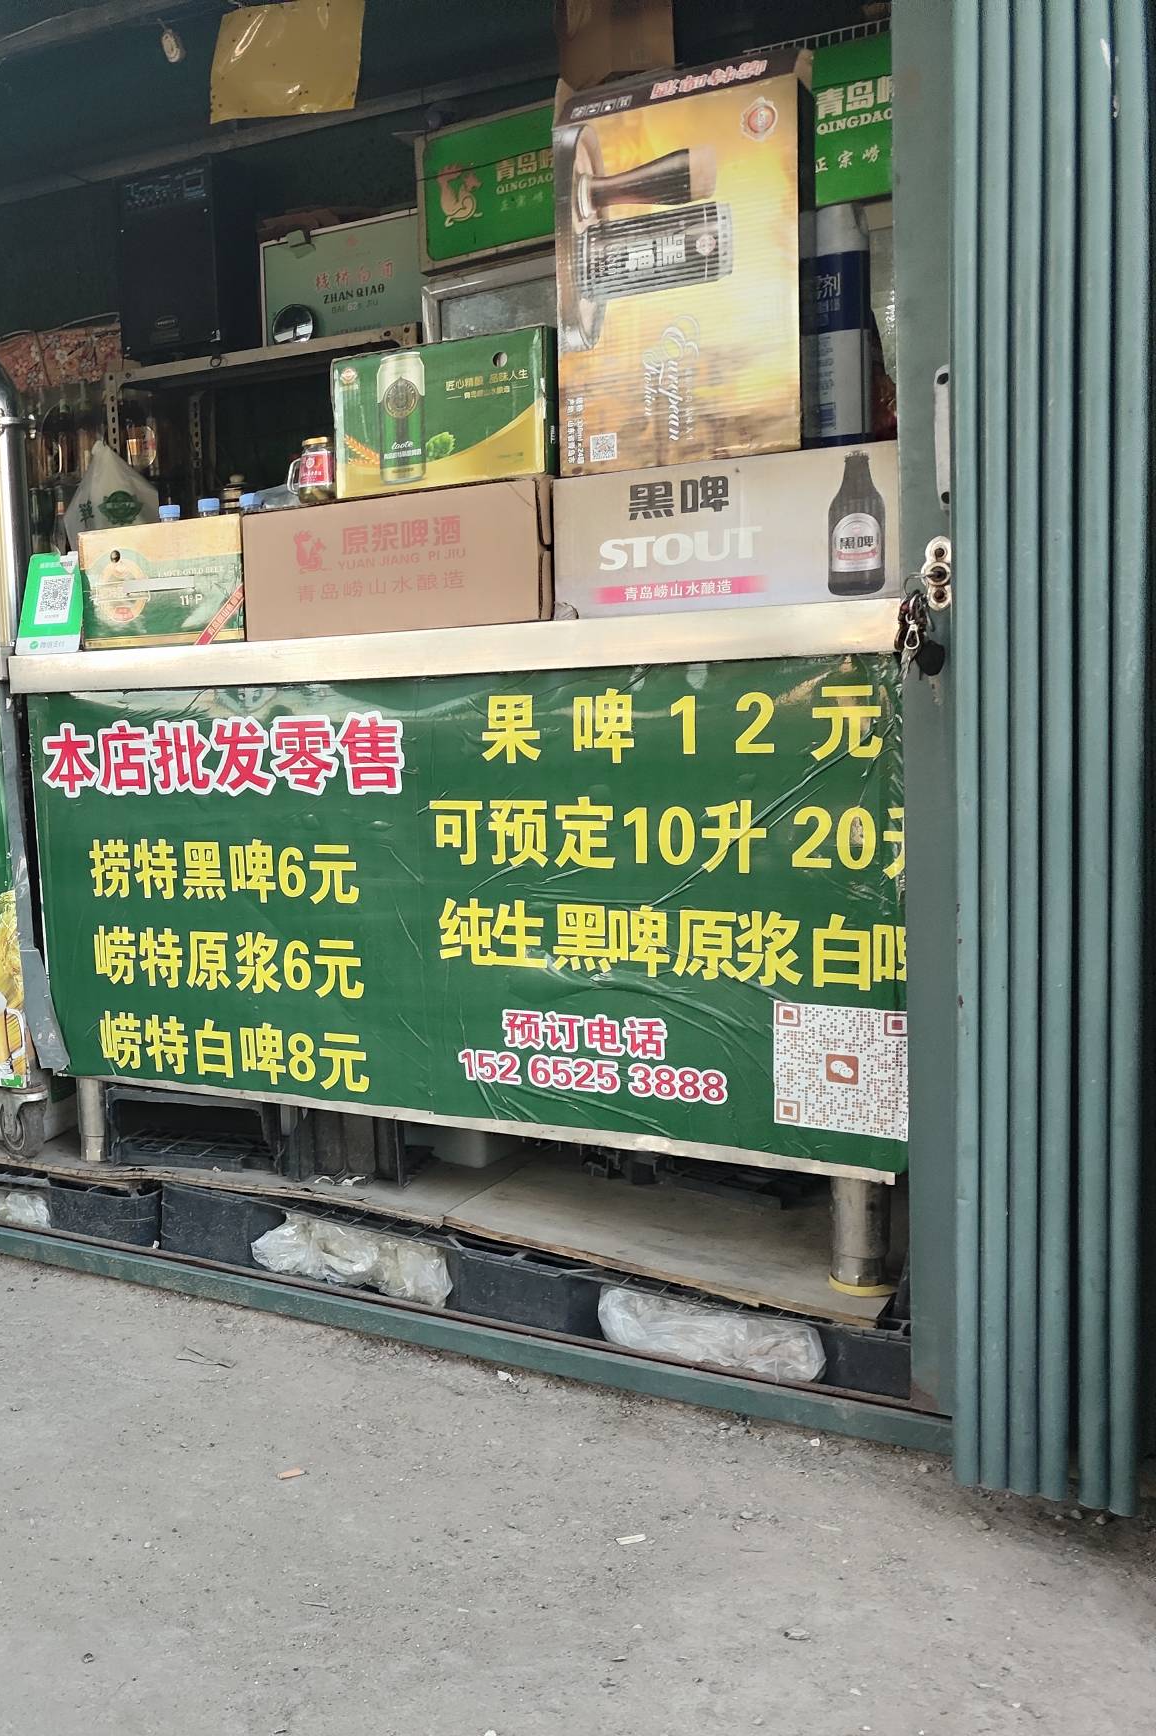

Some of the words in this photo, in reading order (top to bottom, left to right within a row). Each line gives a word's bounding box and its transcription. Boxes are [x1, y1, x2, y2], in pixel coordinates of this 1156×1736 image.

[629, 475, 729, 520] 黑啤
[342, 515, 461, 555] 原浆啤酒
[599, 526, 763, 571] STOUT
[337, 558, 375, 571] YUAN
[379, 552, 420, 567] JIANG
[297, 569, 466, 603] 青岛崂山水酿造
[624, 580, 732, 601] 青岛崂山水酿造
[45, 713, 403, 795] 本店批发零售
[89, 838, 360, 905] 捞特黑啤6元
[93, 925, 365, 999] 崂特原浆6元
[99, 1010, 370, 1093] 崂特白啤8元
[503, 1010, 666, 1059] 预订电话
[459, 1050, 521, 1084] 152
[529, 1056, 619, 1092] 6525
[629, 1064, 726, 1103] 3888
